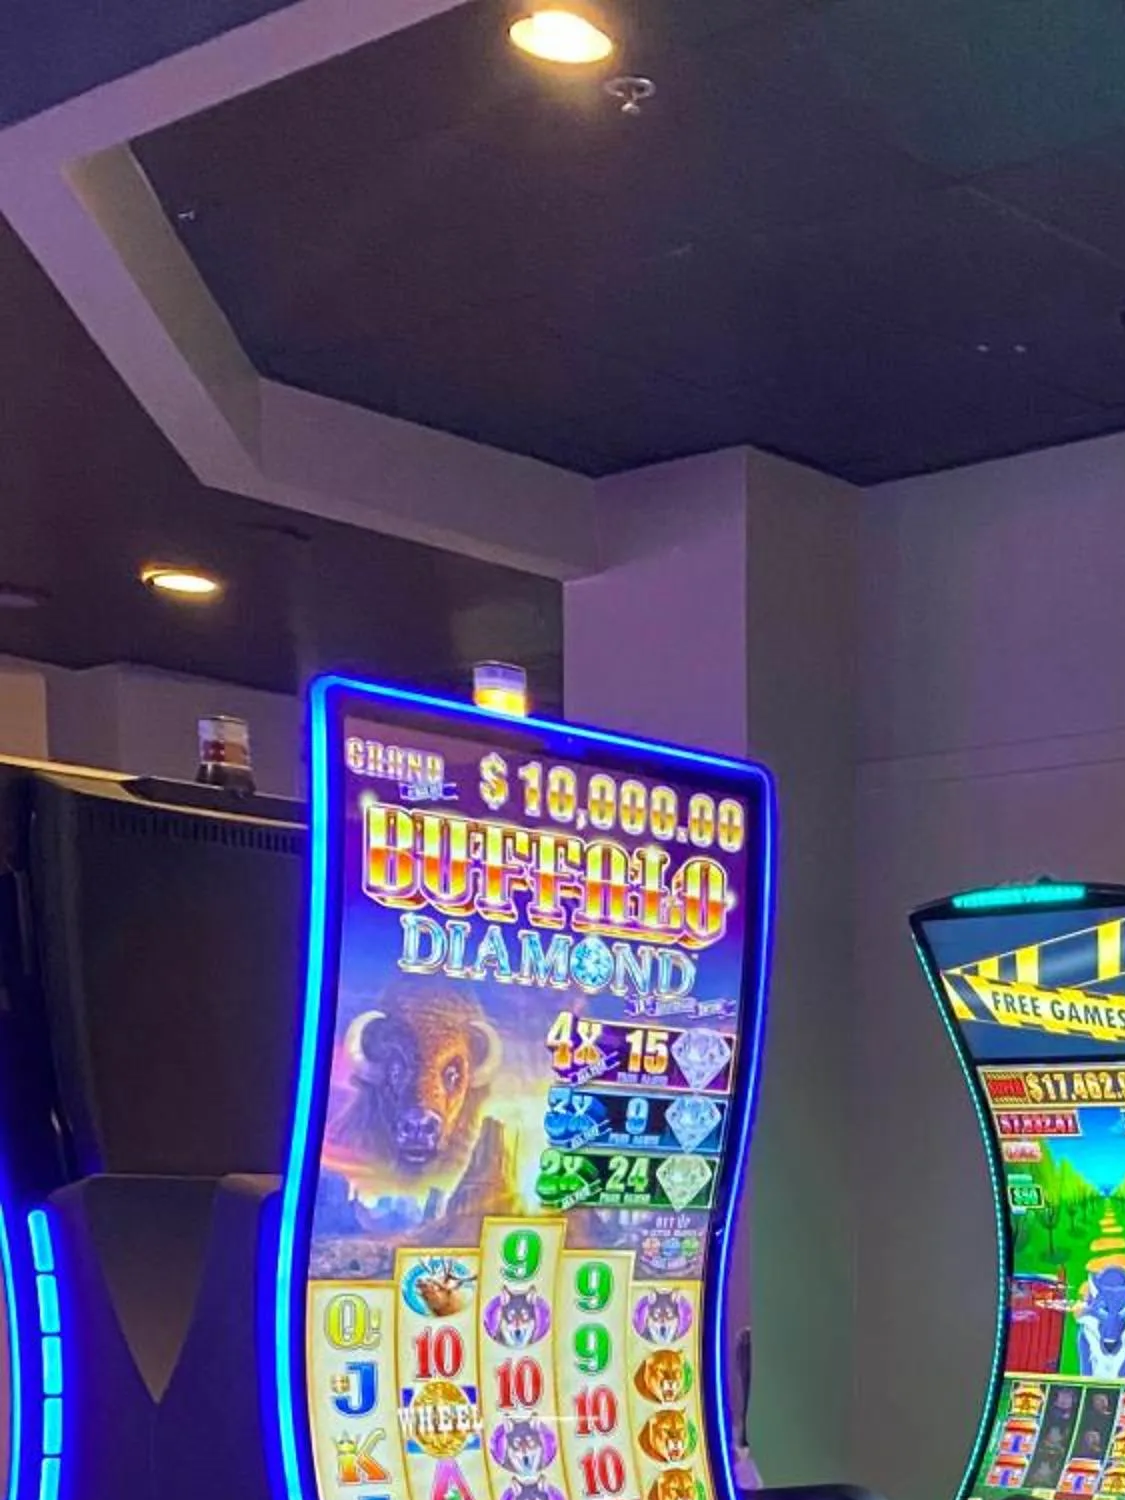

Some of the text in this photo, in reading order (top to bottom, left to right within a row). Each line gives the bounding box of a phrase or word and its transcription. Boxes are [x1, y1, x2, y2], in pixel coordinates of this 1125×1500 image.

[362, 804, 729, 949] BUFFALO
[398, 914, 697, 997] DIAMOND
[992, 991, 1042, 1018] FREE
[625, 1029, 669, 1075] 15
[605, 1155, 650, 1193] 24
[501, 1228, 543, 1282] 9
[575, 1261, 614, 1313] 9
[325, 1293, 381, 1350] Q
[412, 1325, 463, 1382] 10
[574, 1322, 611, 1375] 9
[332, 1361, 379, 1418] J
[496, 1356, 544, 1411] 10
[399, 1404, 483, 1434] WHEEL
[574, 1384, 617, 1437] 10
[337, 1428, 391, 1485] K
[579, 1446, 626, 1499] 10
